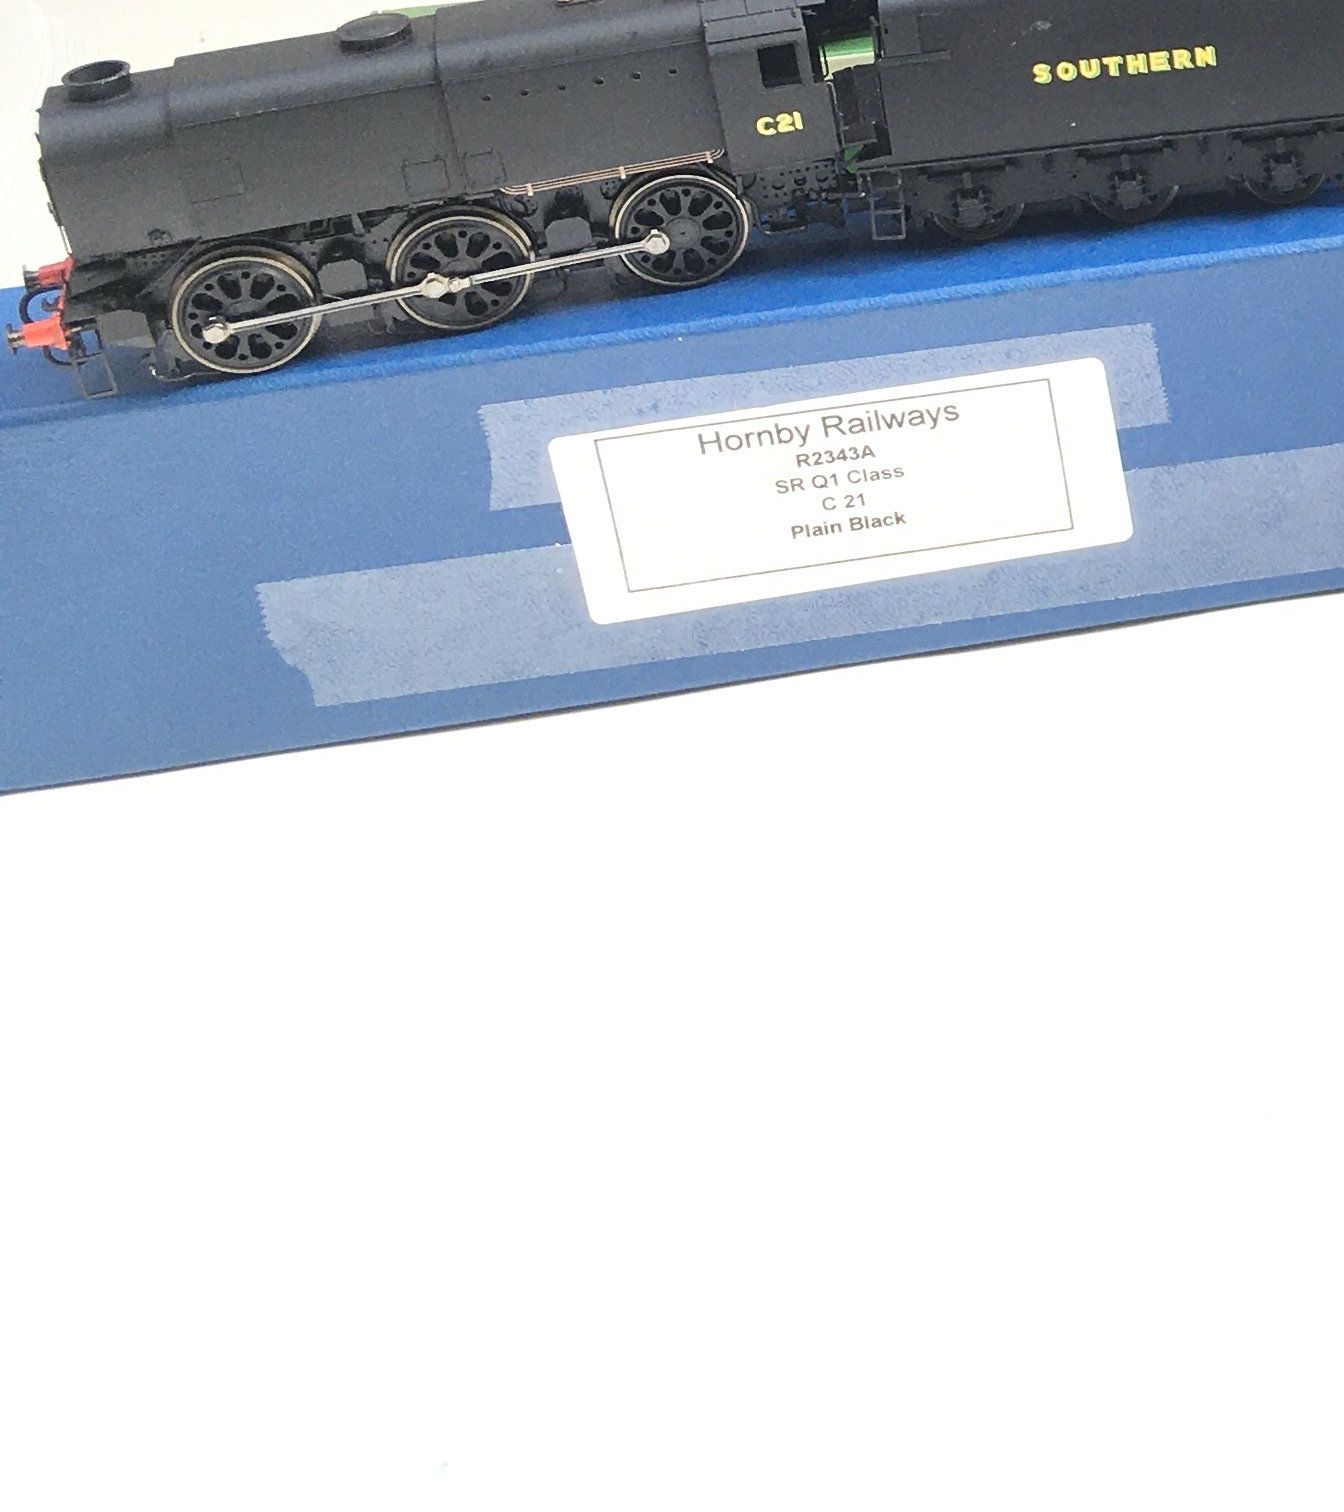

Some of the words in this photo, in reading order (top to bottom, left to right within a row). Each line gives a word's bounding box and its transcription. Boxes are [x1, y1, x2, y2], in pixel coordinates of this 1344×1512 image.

[1032, 45, 1218, 85] SOUTHERN
[756, 111, 804, 137] C21
[698, 422, 811, 455] Hornby
[821, 403, 960, 438] Railways
[795, 444, 876, 468] R2343A
[775, 477, 806, 495] SR
[811, 473, 839, 490] Q1
[847, 466, 905, 485] Class
[821, 496, 837, 511] C
[844, 493, 866, 509] 21
[790, 521, 843, 539] Plain
[849, 511, 907, 532] Black
